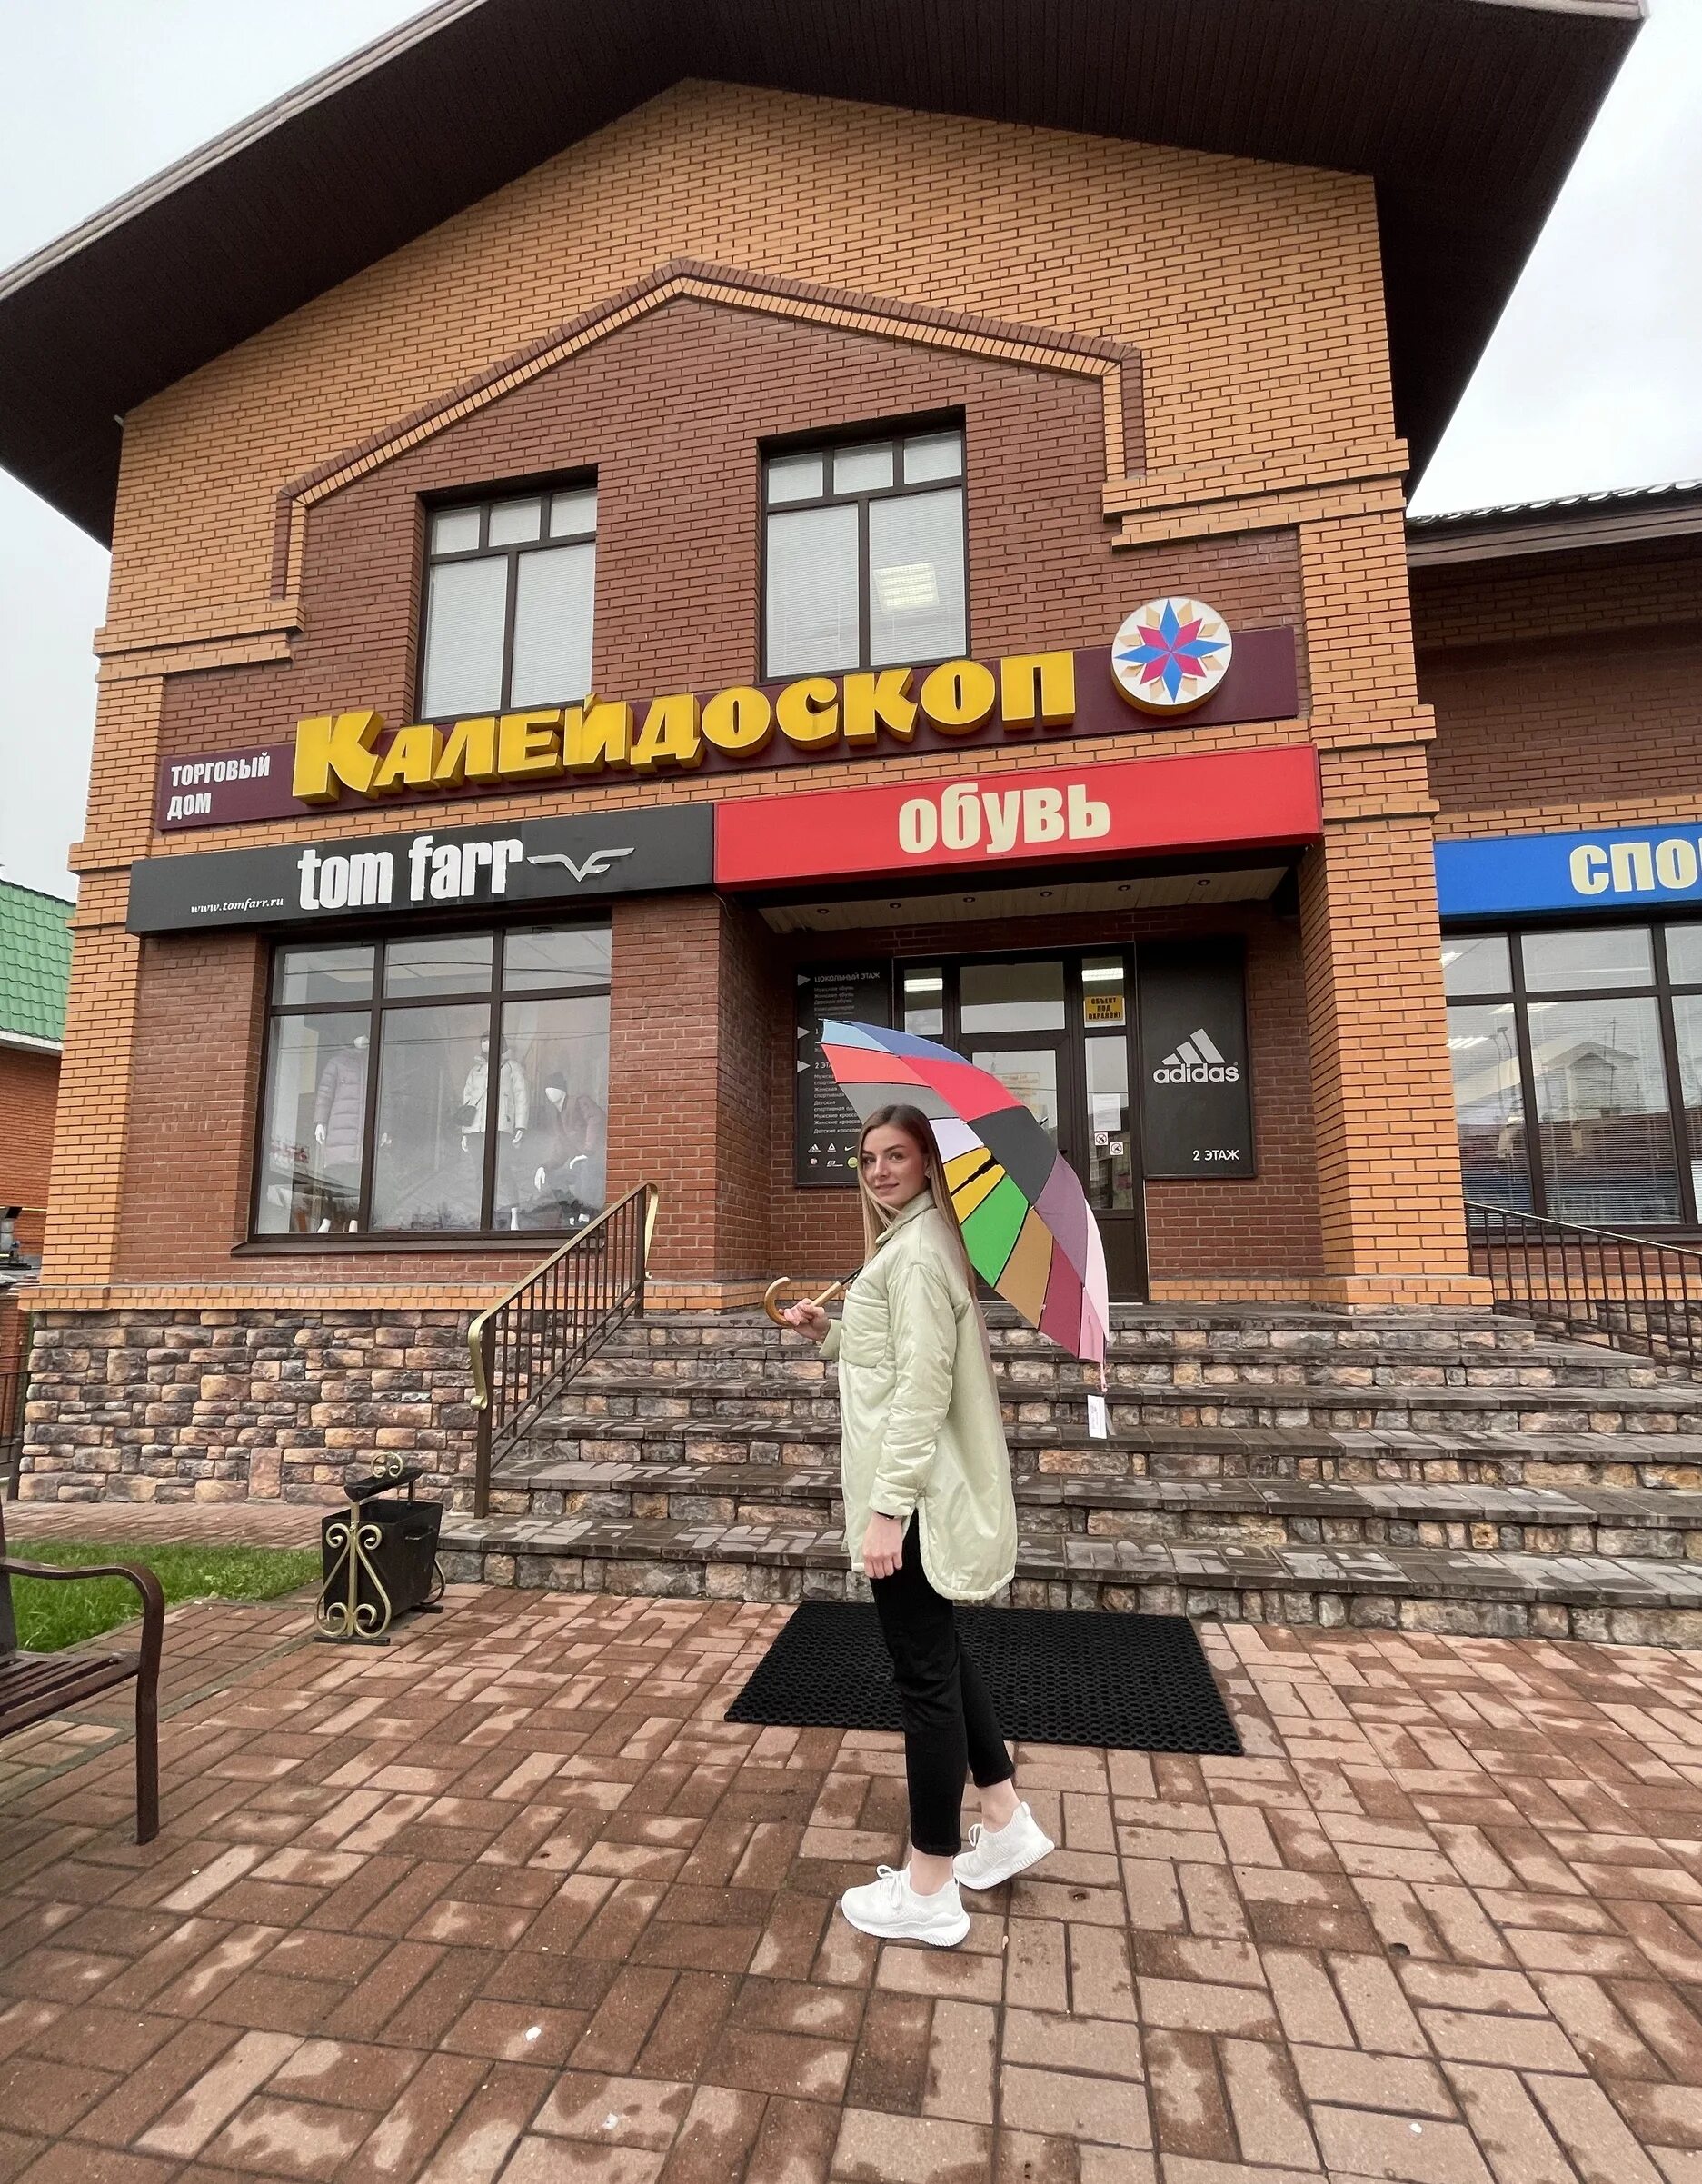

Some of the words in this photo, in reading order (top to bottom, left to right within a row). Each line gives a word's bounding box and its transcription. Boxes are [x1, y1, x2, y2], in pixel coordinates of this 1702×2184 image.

[171, 752, 271, 787] ТОРГОВЫЙ
[167, 793, 212, 821] ДОМ
[898, 782, 1110, 853] обувь
[297, 849, 393, 910] tom
[408, 835, 523, 901] farr
[1569, 837, 1702, 895] спо
[191, 897, 284, 913] www.tomfarr.ru
[861, 972, 881, 980] ЭТАЖ
[815, 1062, 820, 1070] 2
[1153, 1062, 1239, 1084] adidas
[1192, 1150, 1200, 1161] 2
[1204, 1149, 1240, 1161] ЭТАЖ
